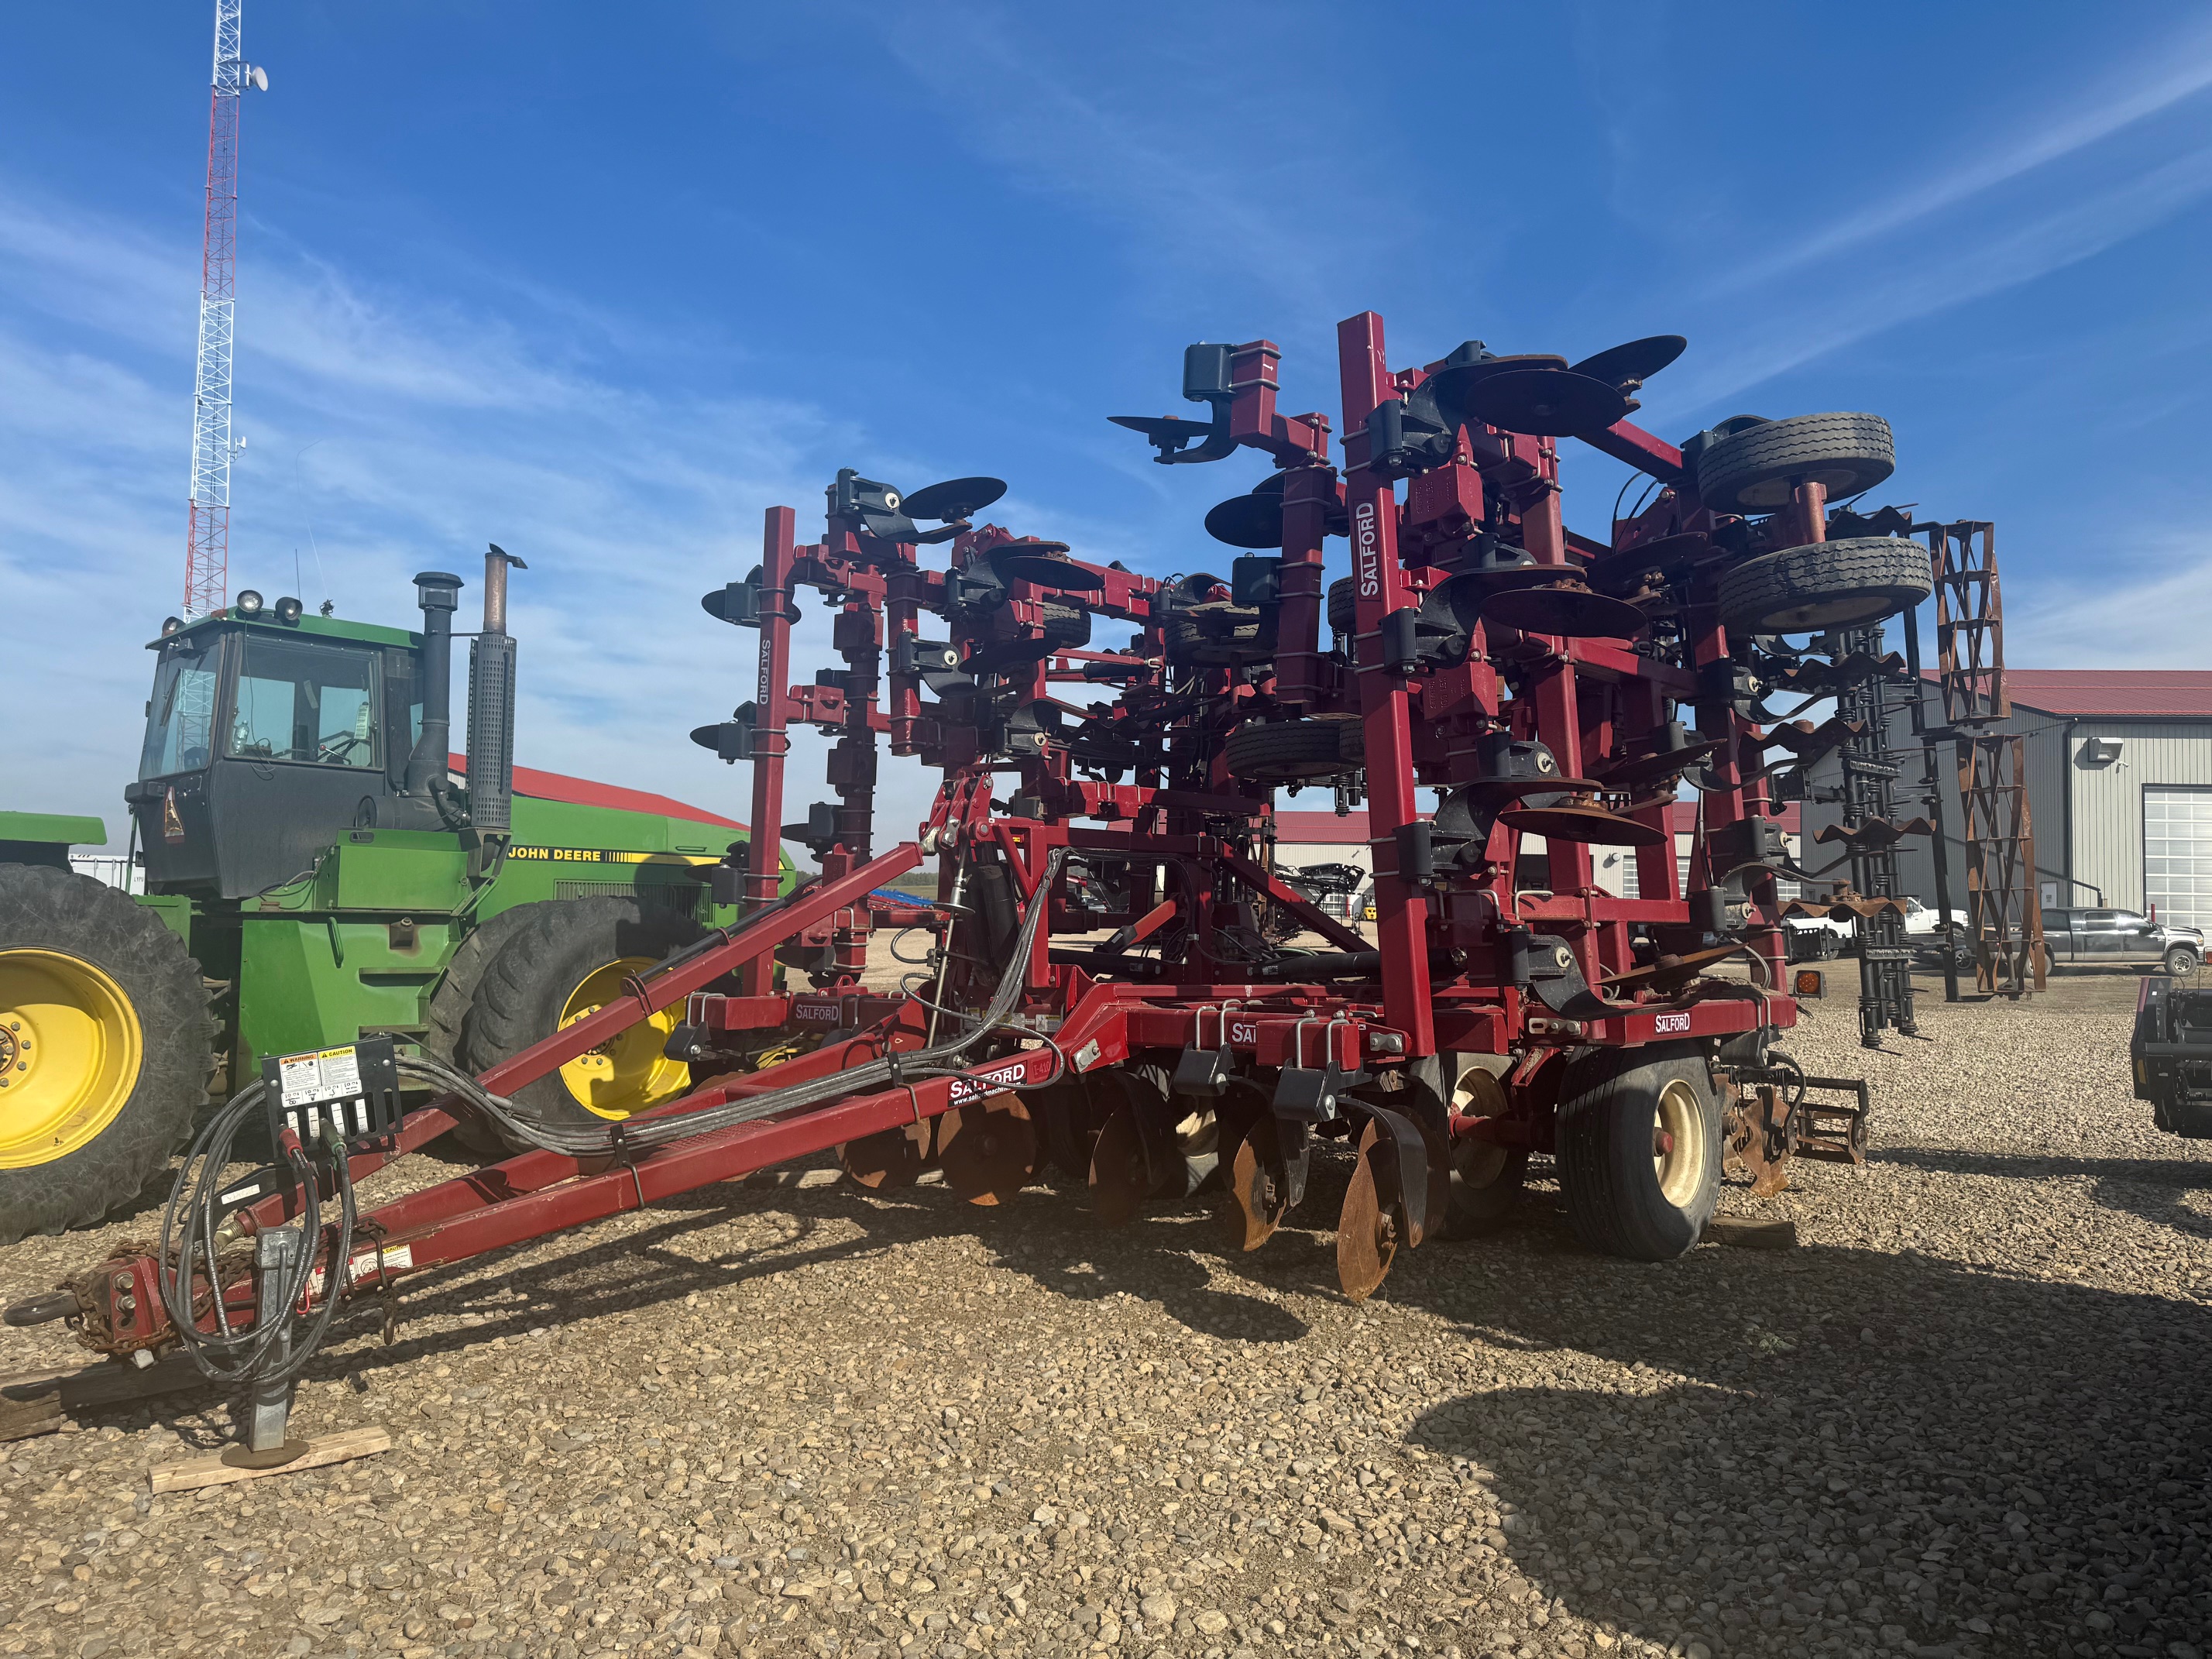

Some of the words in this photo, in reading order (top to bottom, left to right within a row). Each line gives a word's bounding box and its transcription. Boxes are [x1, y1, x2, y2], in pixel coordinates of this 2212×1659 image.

[1356, 502, 1379, 596] SALFORD
[759, 639, 771, 706] SALFORD
[508, 847, 549, 860] JOHN
[554, 849, 601, 862] DEERE
[795, 1004, 839, 1022] SALFORD
[1655, 1012, 1690, 1033] SALFORD
